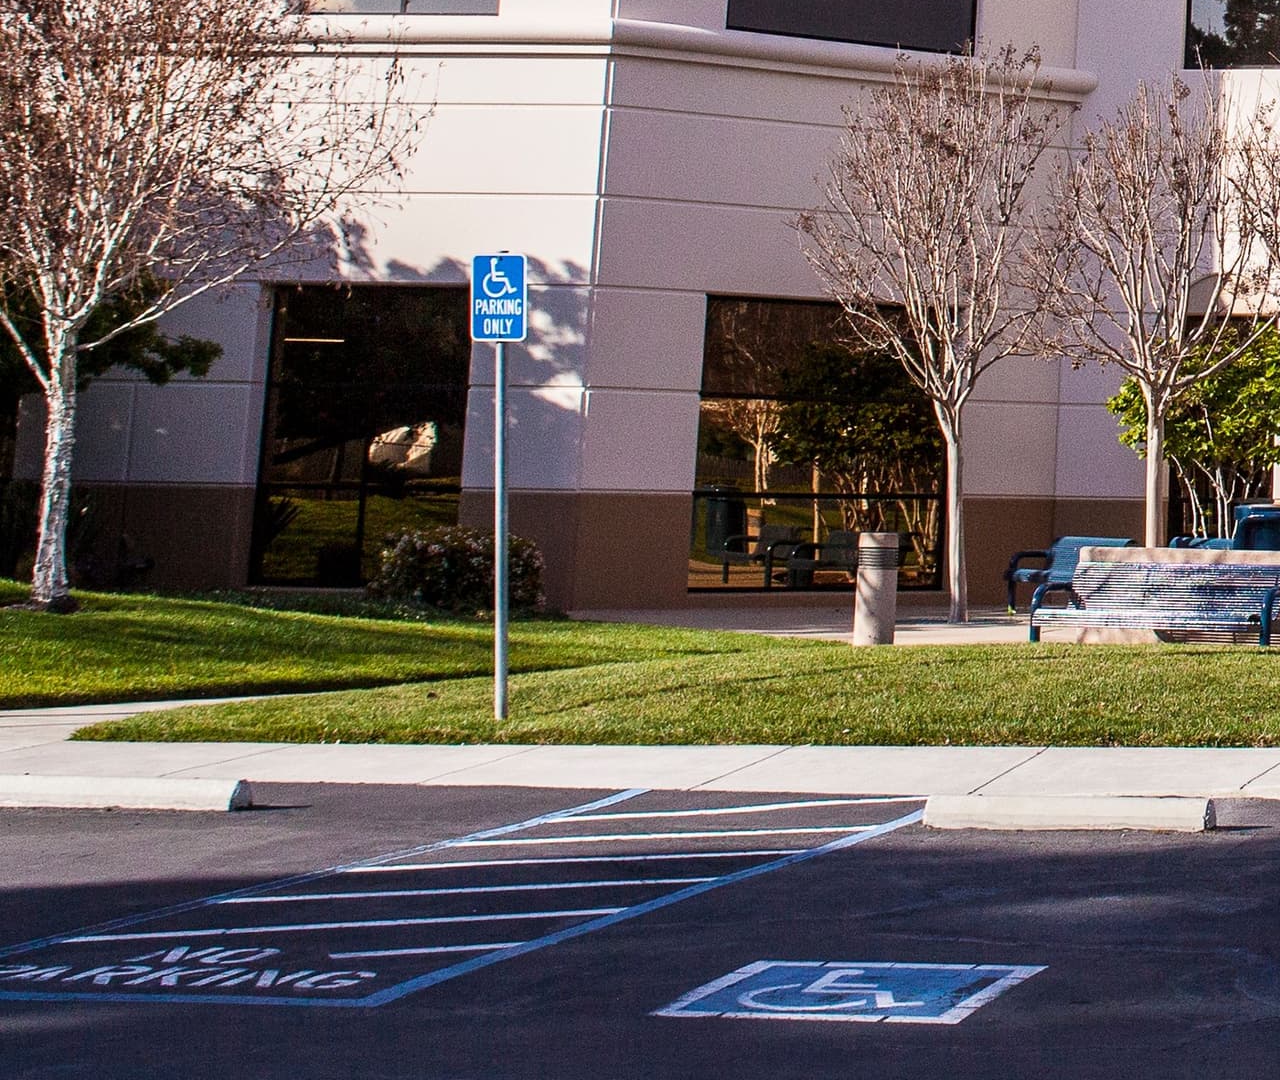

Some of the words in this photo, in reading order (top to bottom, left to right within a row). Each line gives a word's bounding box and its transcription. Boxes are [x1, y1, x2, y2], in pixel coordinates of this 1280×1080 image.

[475, 299, 522, 316] PARKING
[483, 318, 513, 335] ONLY
[122, 946, 282, 964] NO
